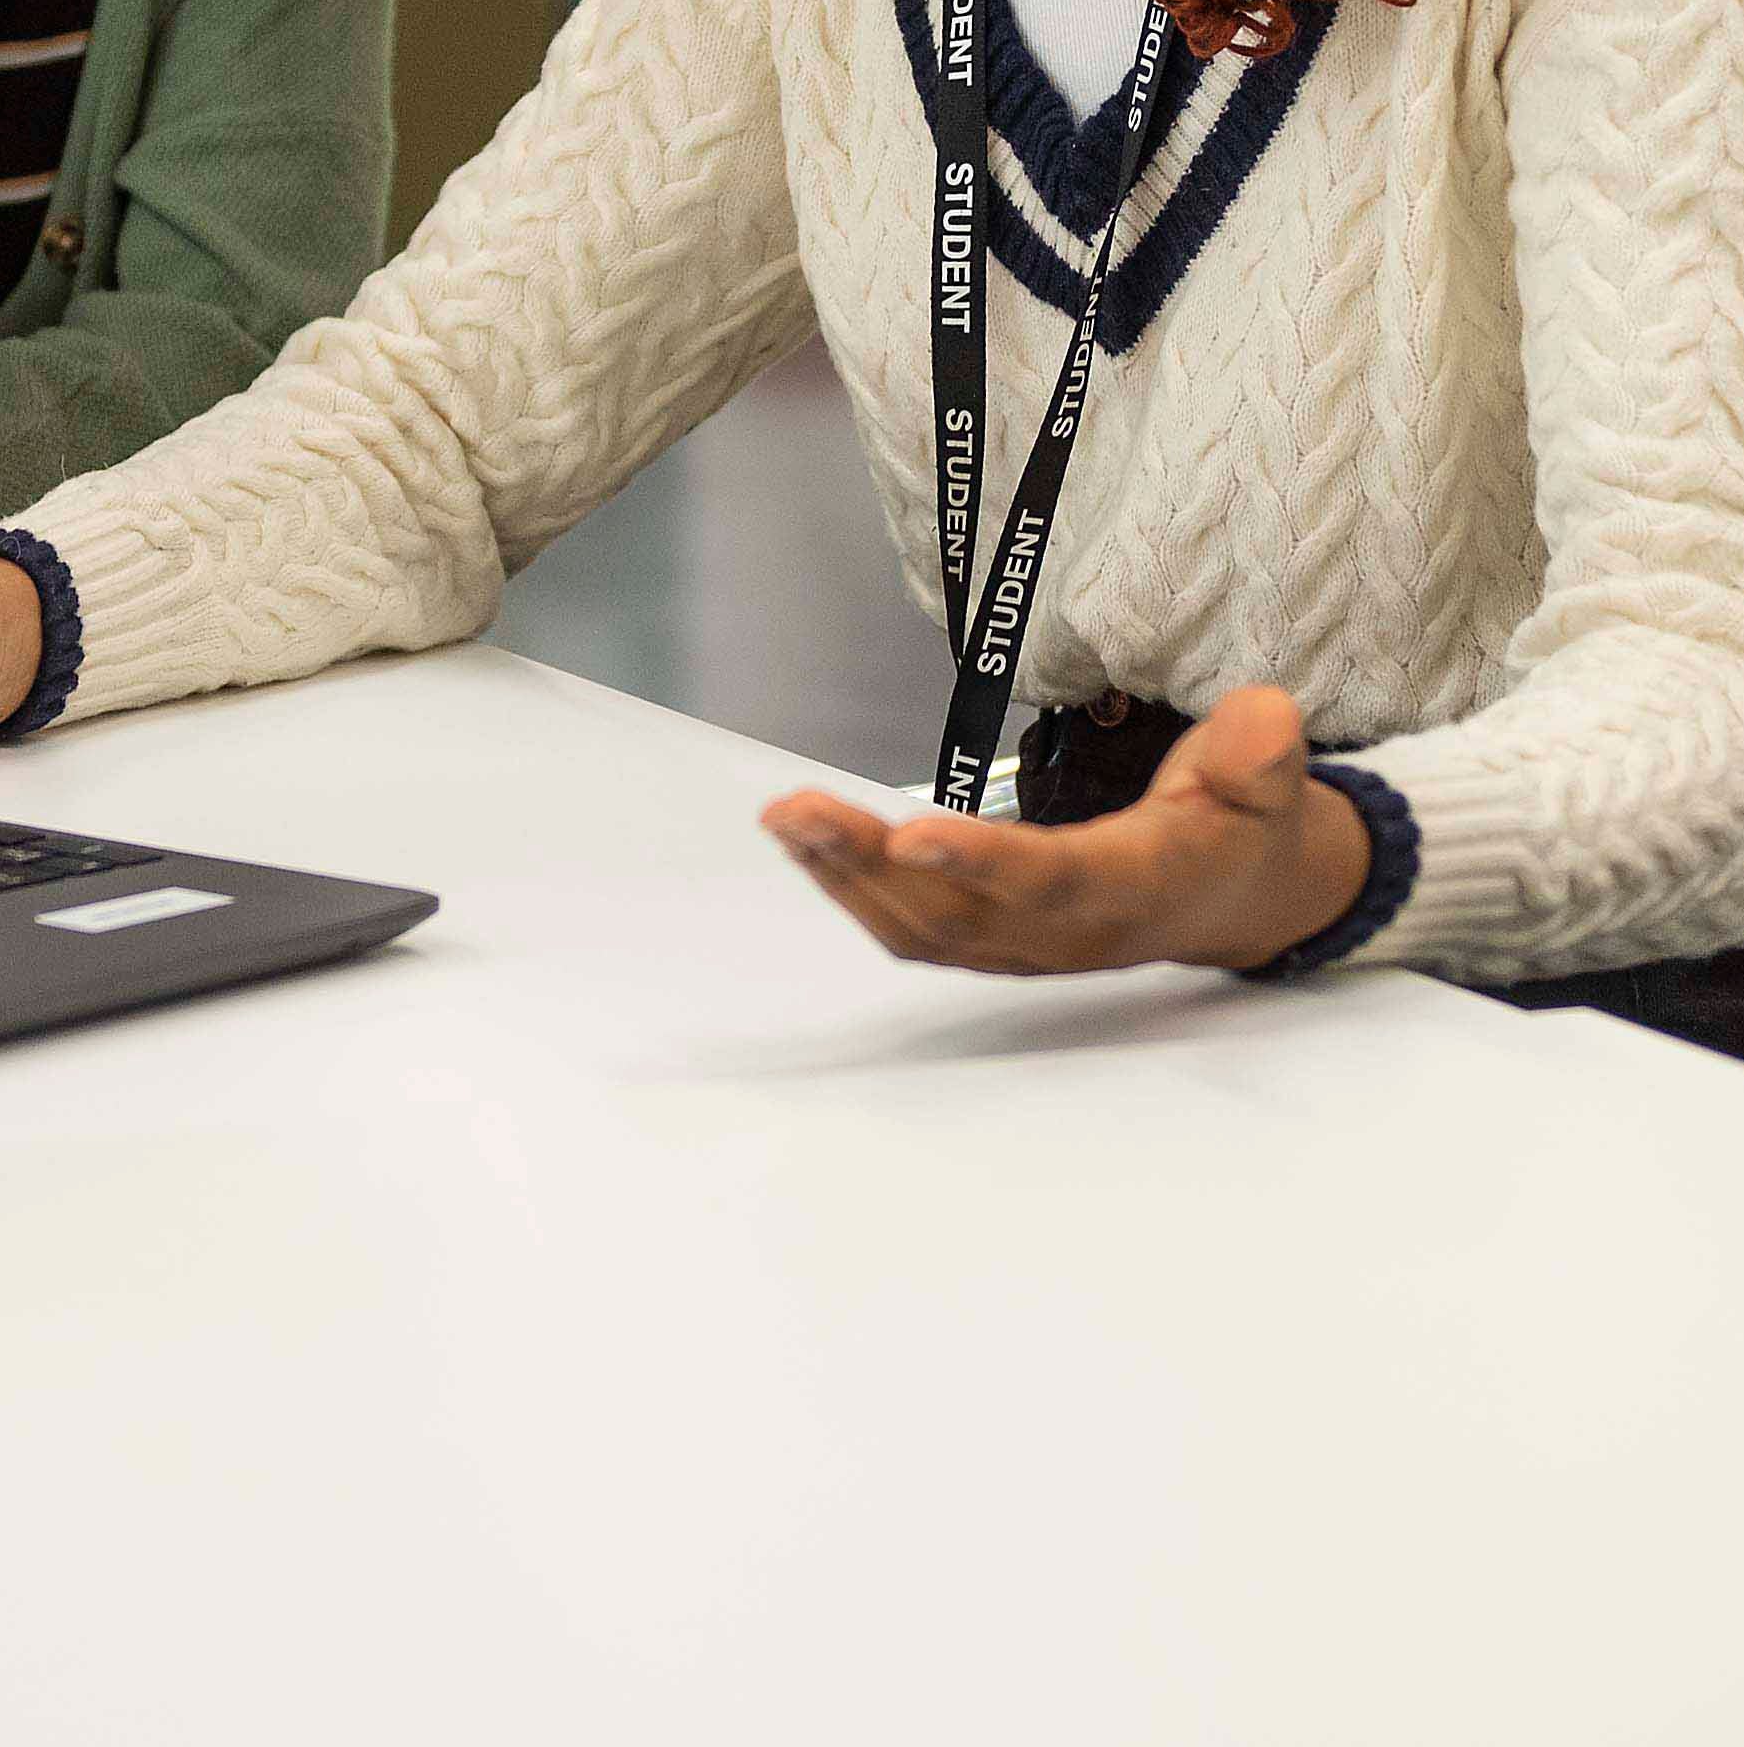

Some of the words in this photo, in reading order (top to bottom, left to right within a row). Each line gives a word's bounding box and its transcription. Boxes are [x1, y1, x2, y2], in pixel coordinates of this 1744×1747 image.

[941, 162, 975, 334] STUDENT
[1051, 274, 1103, 440] STUDENT
[943, 408, 973, 584] STUDENT
[976, 508, 1045, 677] STUDENT
